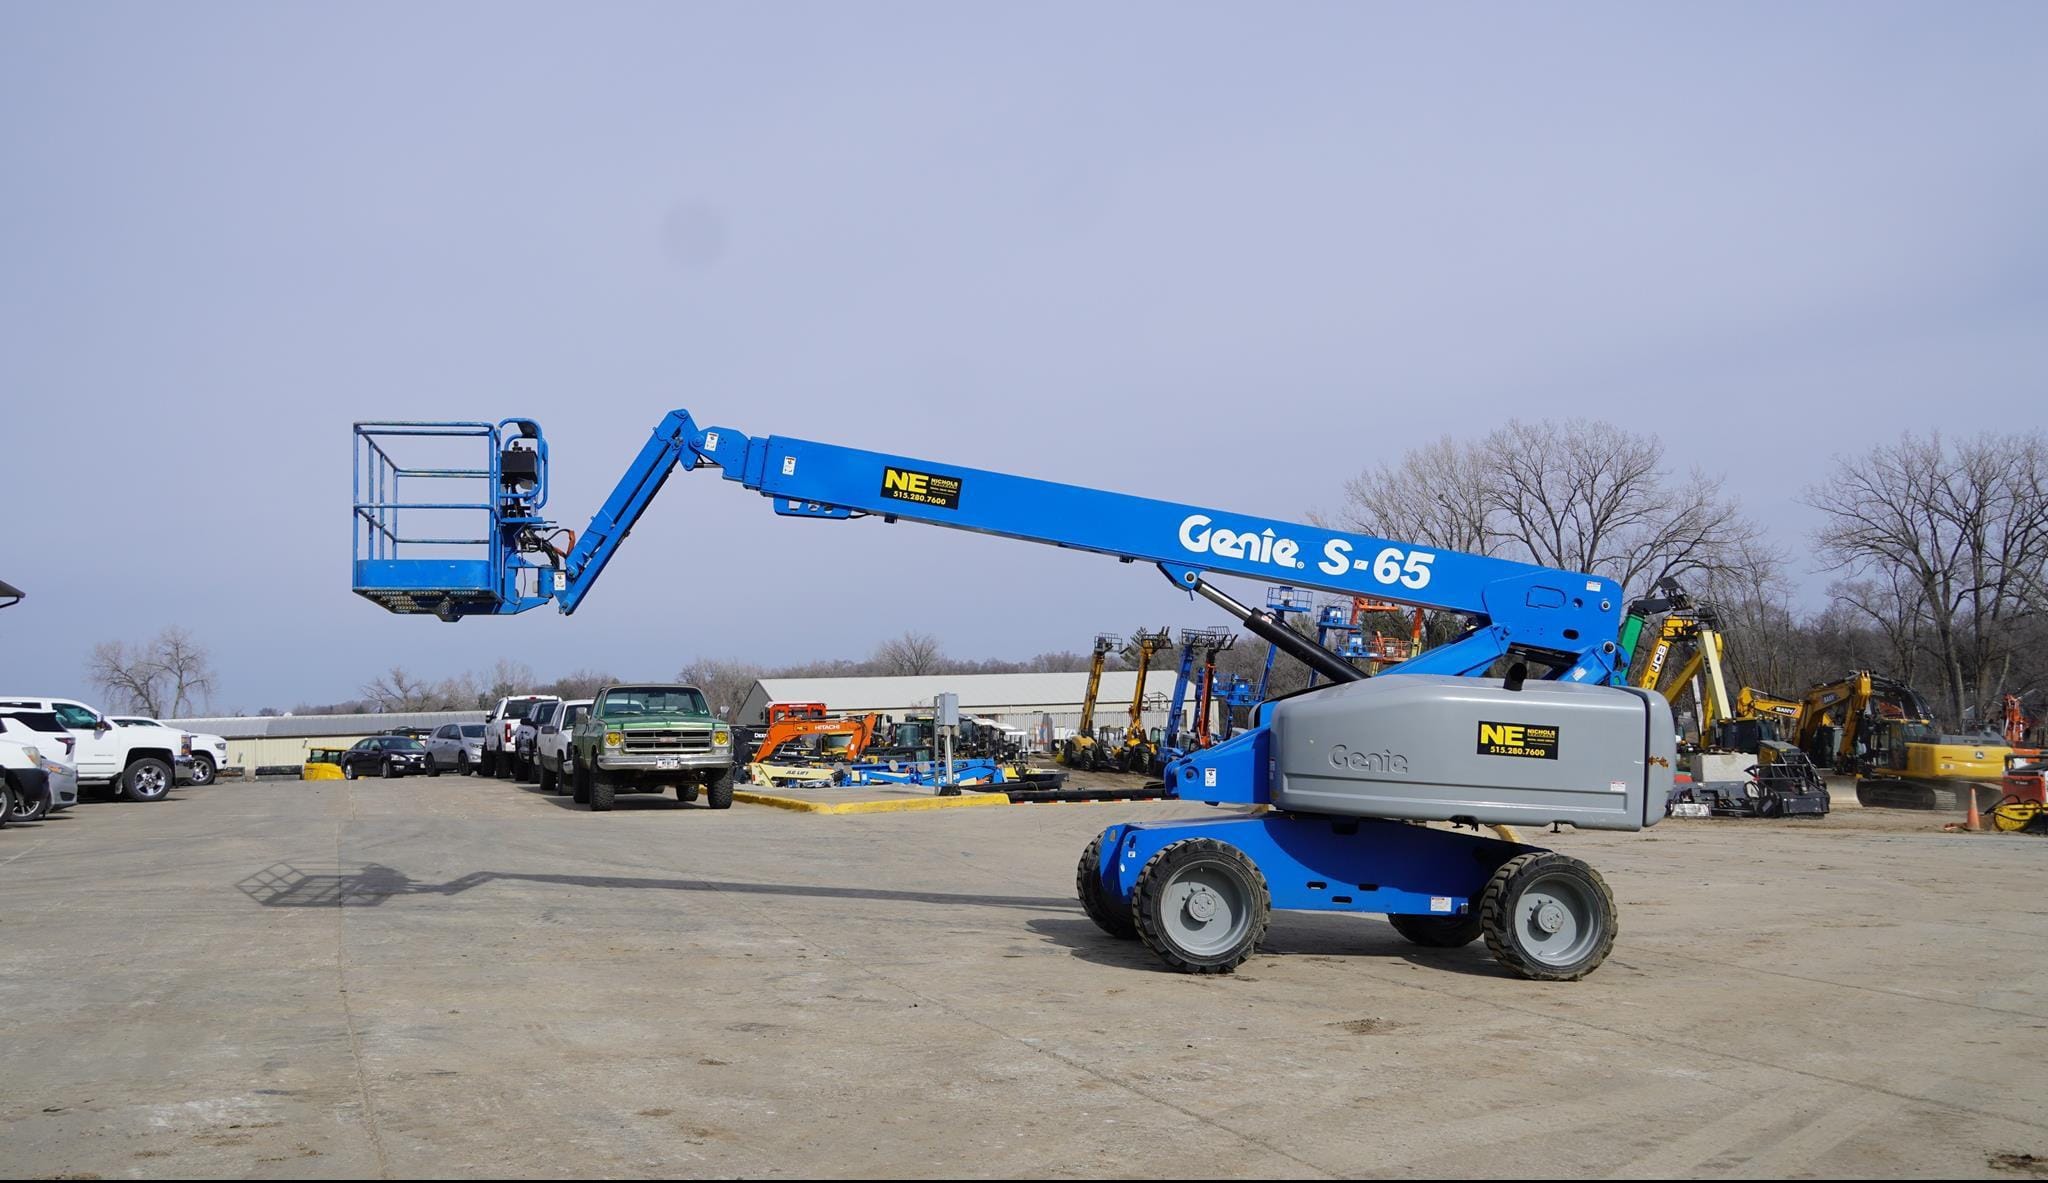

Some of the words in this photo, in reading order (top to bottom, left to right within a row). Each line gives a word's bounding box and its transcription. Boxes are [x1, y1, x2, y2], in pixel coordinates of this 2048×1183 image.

[884, 469, 929, 494] NE
[893, 490, 946, 505] 515.280.7600
[1178, 514, 1299, 568] Genie
[1317, 538, 1436, 590] S-65
[1652, 645, 1667, 673] JCB
[1775, 706, 1794, 714] SANY
[1480, 724, 1525, 746] NE
[1327, 743, 1409, 774] Genie
[1490, 746, 1545, 756] 515.280.7600
